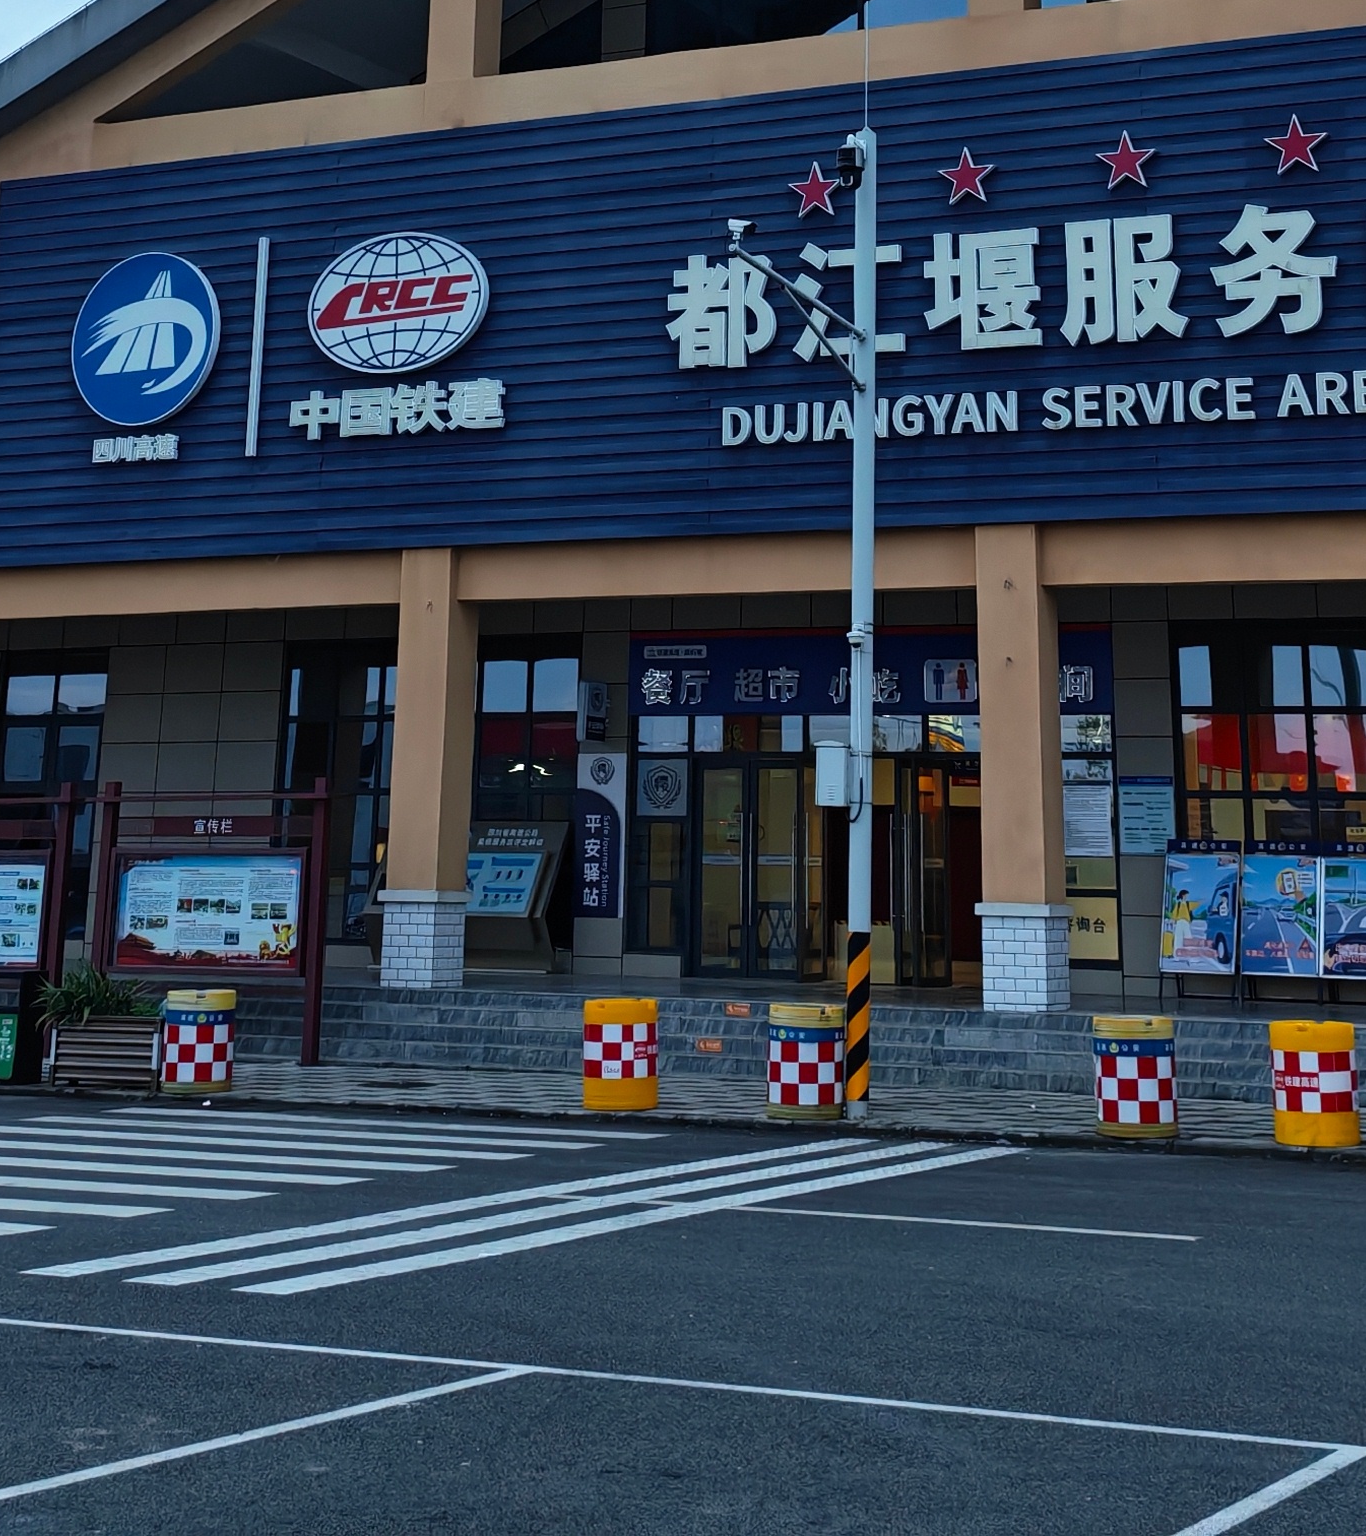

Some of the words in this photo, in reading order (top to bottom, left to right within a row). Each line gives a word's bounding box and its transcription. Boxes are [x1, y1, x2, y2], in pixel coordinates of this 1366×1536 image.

[316, 274, 472, 330] CRCC
[289, 378, 506, 440] 中国铁建
[1041, 376, 1256, 431] SERVICE
[92, 433, 180, 463] 四川高速
[641, 668, 710, 705] 餐厅
[734, 666, 800, 703] 超市
[193, 818, 233, 835] 宣传栏
[603, 815, 611, 835] Safe
[583, 814, 602, 907] 平安驿站
[601, 837, 609, 872] Journey
[601, 873, 609, 907] Station
